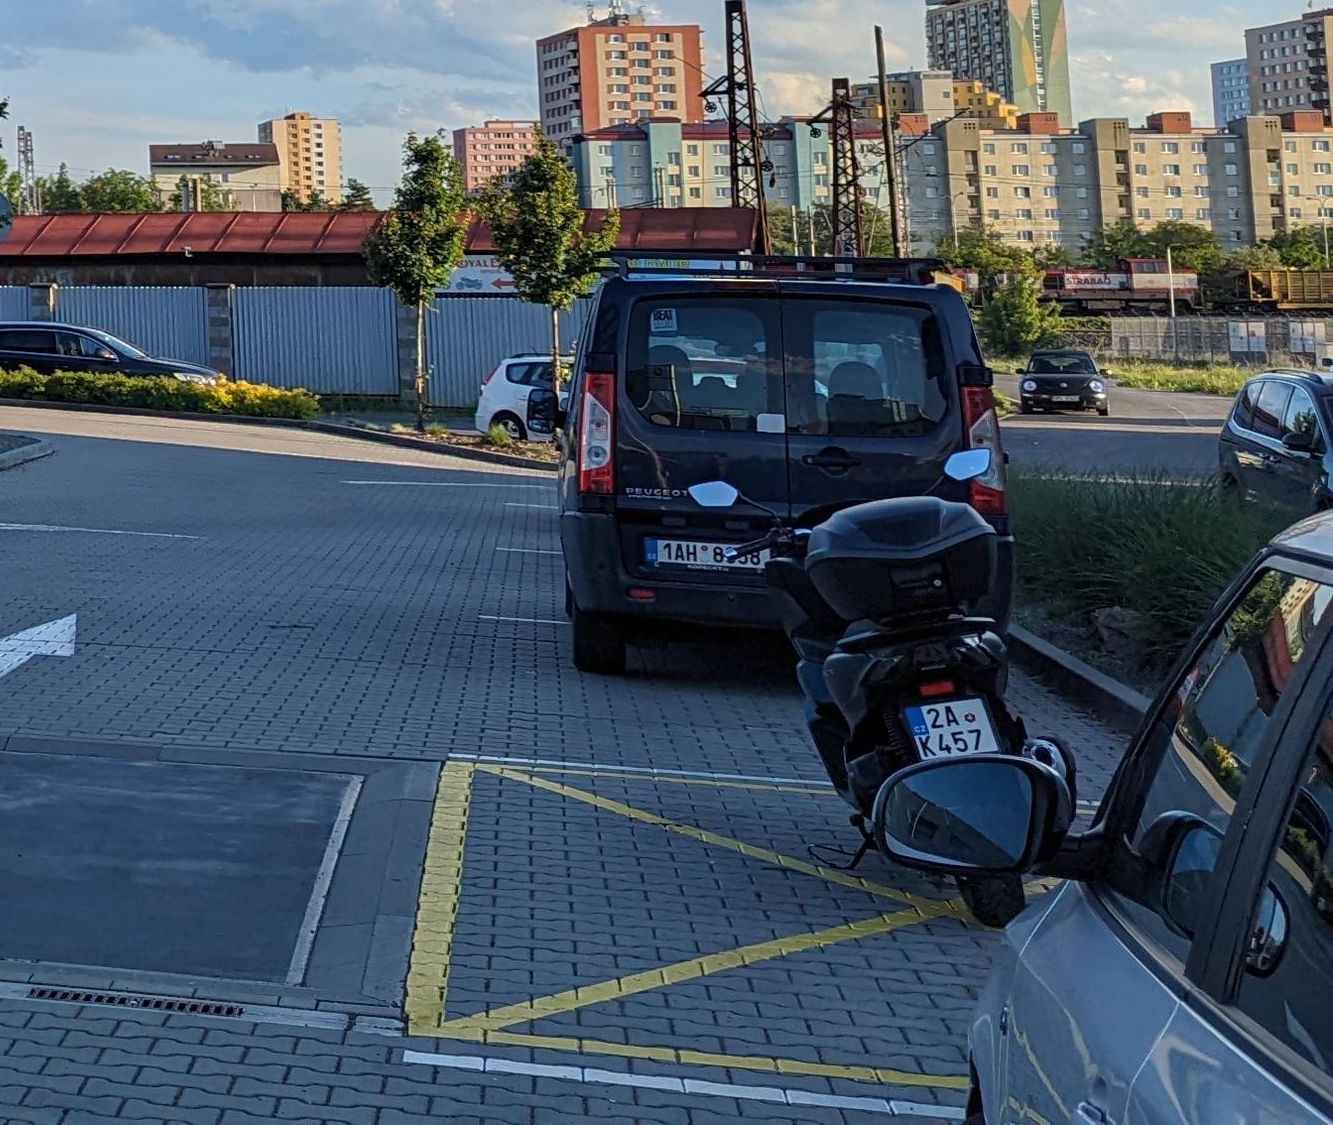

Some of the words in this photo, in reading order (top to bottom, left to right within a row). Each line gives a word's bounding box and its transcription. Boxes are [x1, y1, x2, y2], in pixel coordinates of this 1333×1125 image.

[625, 487, 688, 496] PEUGEOT
[663, 542, 697, 562] 1AH
[926, 706, 960, 729] 2A
[914, 725, 927, 734] CZ
[918, 728, 981, 758] K457
